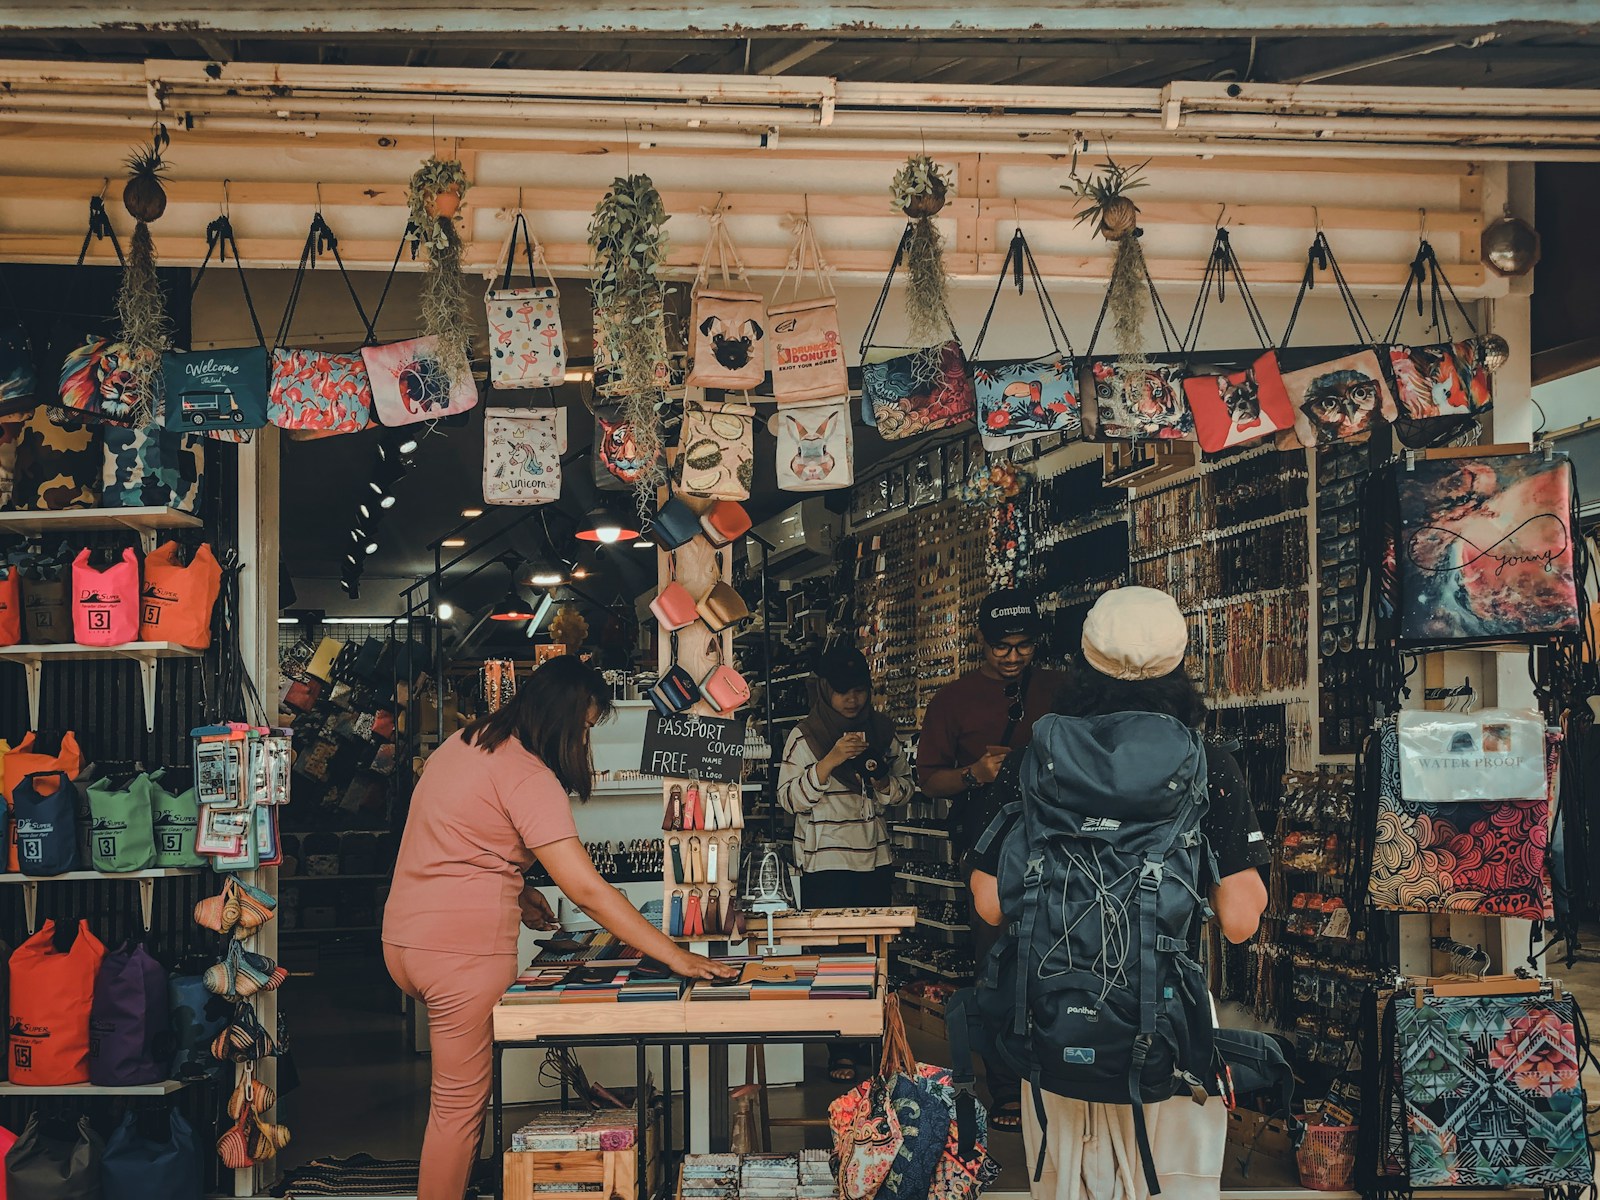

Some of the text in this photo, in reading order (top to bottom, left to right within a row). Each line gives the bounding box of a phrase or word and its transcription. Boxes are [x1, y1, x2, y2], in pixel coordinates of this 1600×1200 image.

[791, 341, 835, 354] DRUNKEN
[792, 349, 837, 363] DONUTS
[815, 358, 838, 366] MOMENT
[186, 359, 239, 376] Welcome
[1494, 550, 1553, 576] young
[147, 608, 154, 621] 5
[991, 605, 1031, 618] Compton
[94, 613, 104, 628] 3
[657, 717, 726, 740] PASSPORT
[707, 741, 744, 757] COVER
[651, 750, 688, 774] FREE
[701, 756, 723, 765] NAME
[1418, 757, 1523, 769] WATER PROOF
[706, 771, 723, 779] LOGO
[173, 814, 197, 822] SUPER
[28, 841, 37, 857] 3
[103, 840, 111, 854] 3
[167, 836, 175, 849] 5
[1067, 1006, 1097, 1015] panther
[23, 1023, 49, 1032] SUPER
[16, 1047, 28, 1065] 15
